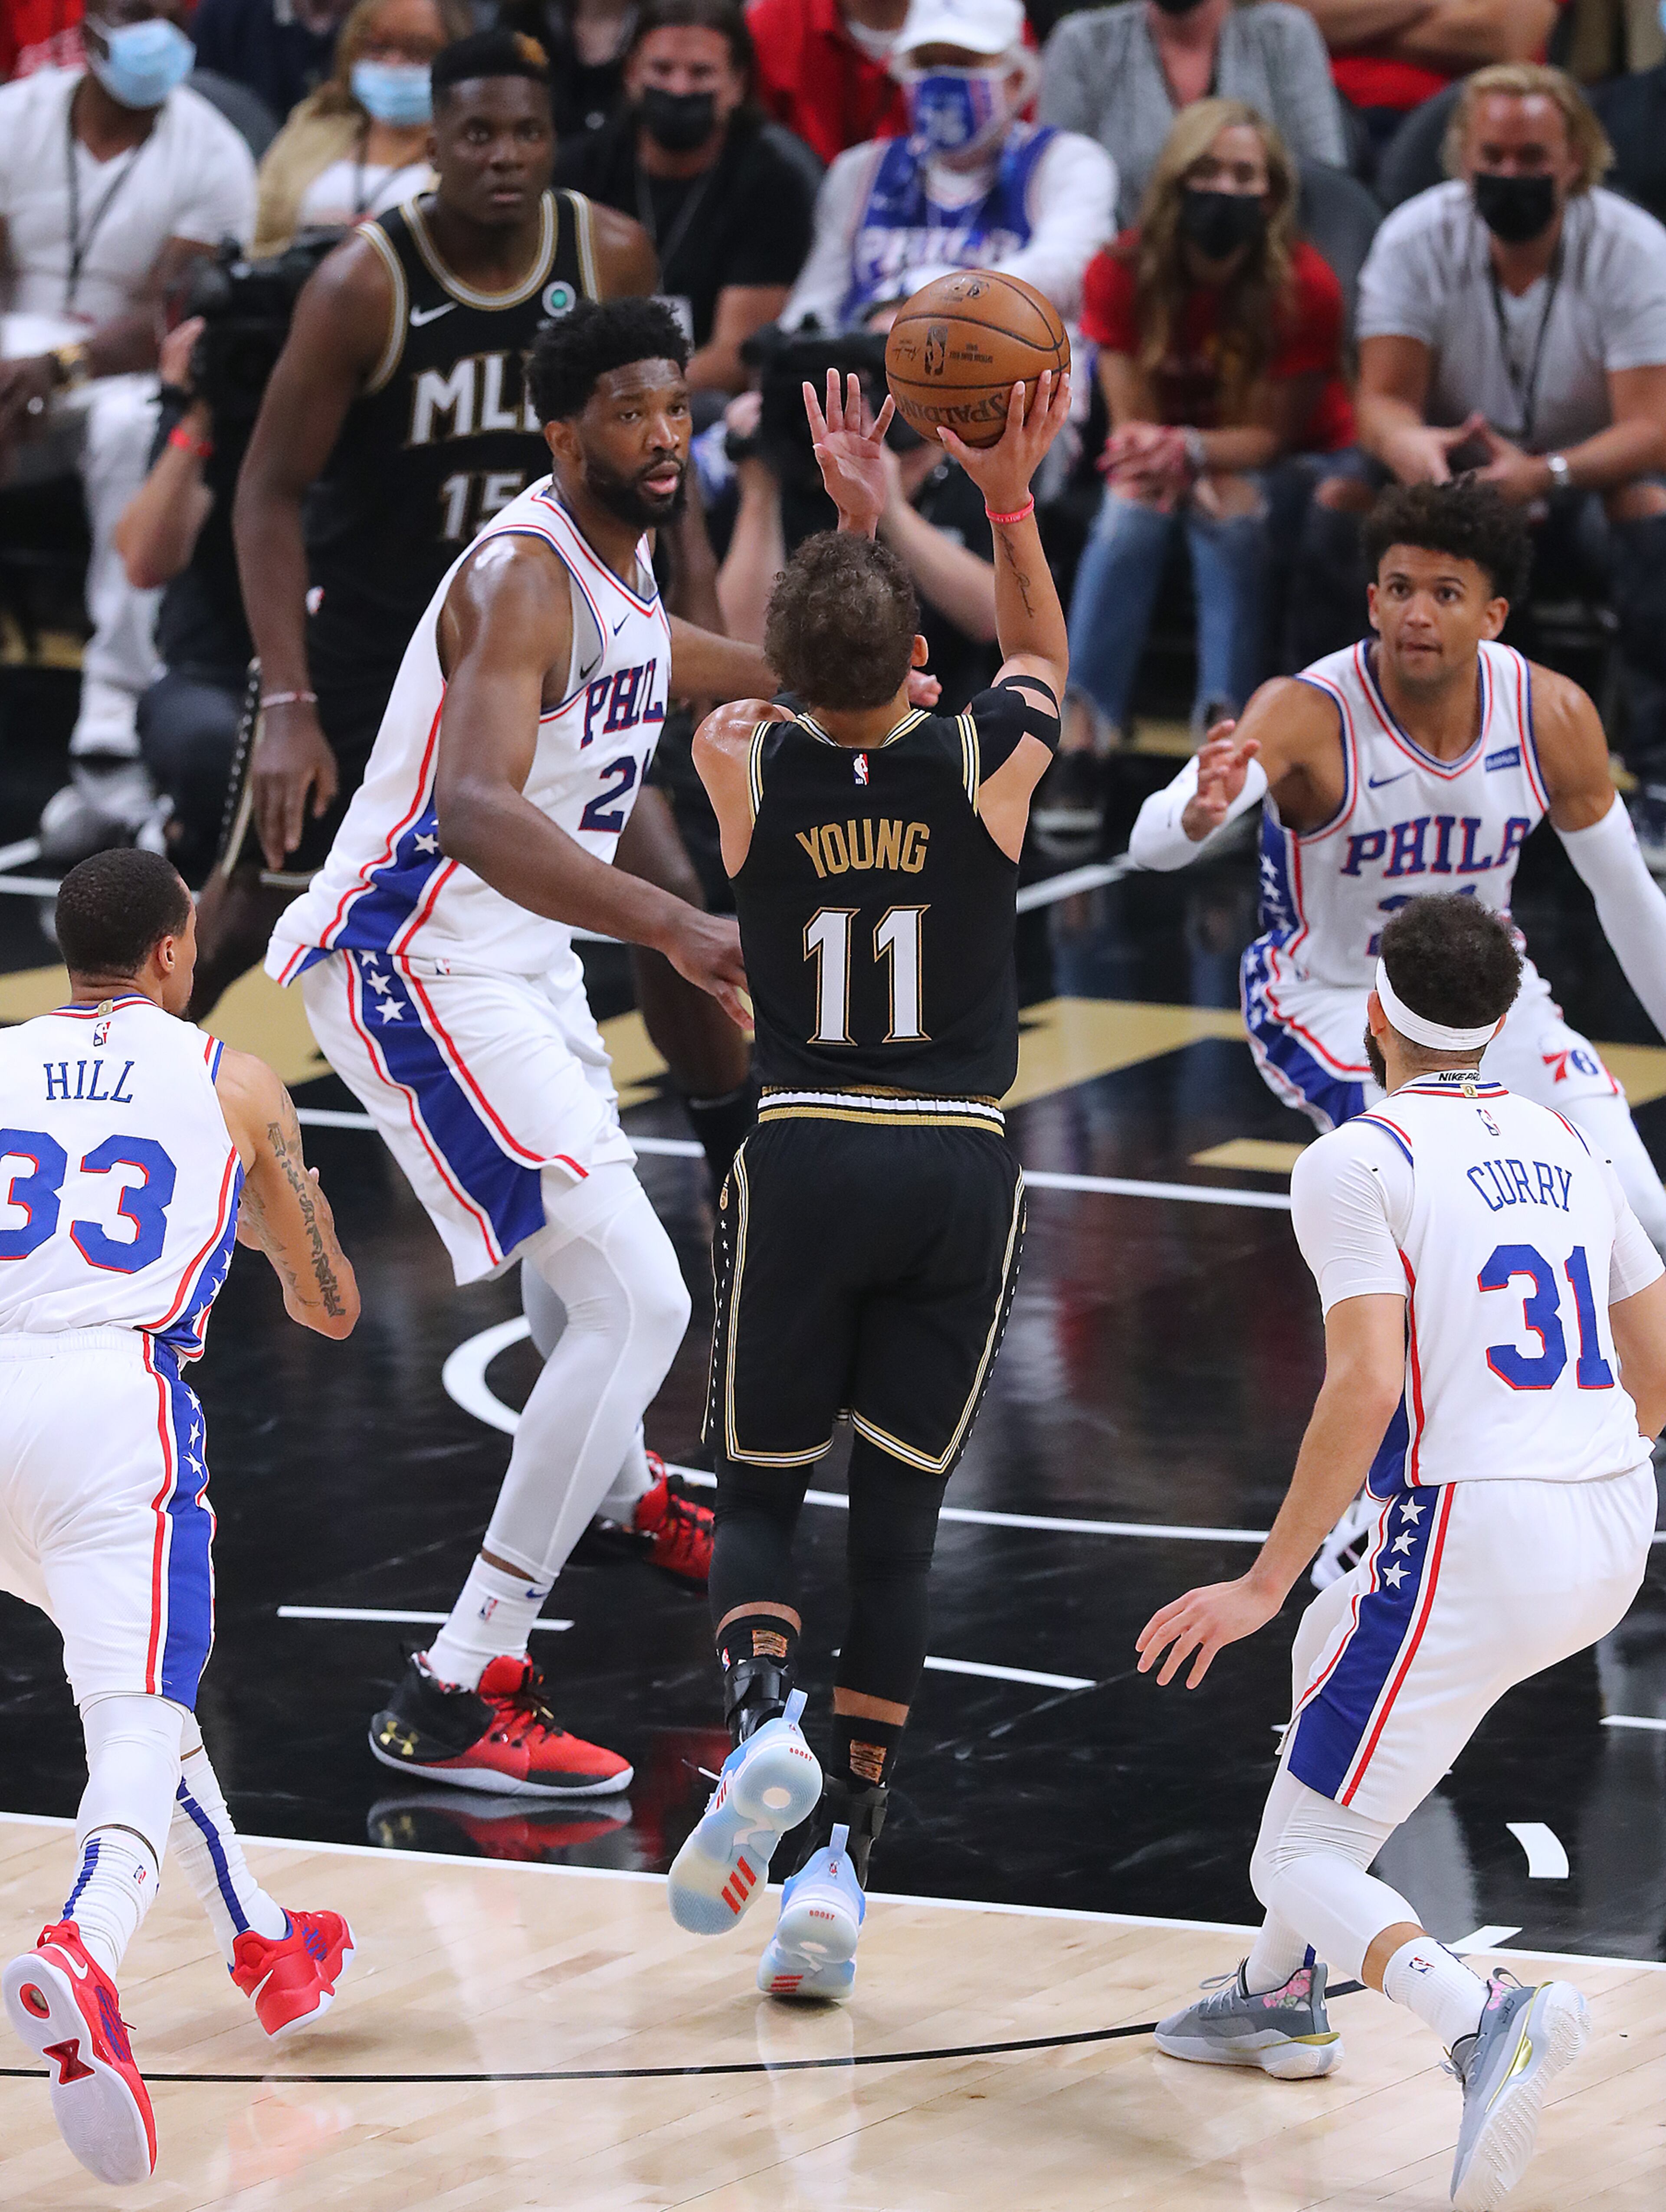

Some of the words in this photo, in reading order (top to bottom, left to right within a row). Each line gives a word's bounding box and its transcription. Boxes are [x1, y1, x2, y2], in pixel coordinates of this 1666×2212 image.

[578, 749, 651, 833] 2
[795, 818, 930, 878] YOUNG
[803, 904, 932, 1047] 11
[43, 1060, 134, 1103] HILL
[1438, 1073, 1466, 1081] NIKE
[1543, 1049, 1598, 1083] 76
[0, 1129, 177, 1275] 33
[1466, 1159, 1572, 1212] CURRY
[1477, 1244, 1615, 1391] 31
[789, 1747, 813, 1761] BOOST
[809, 1909, 835, 1921] BOOST
